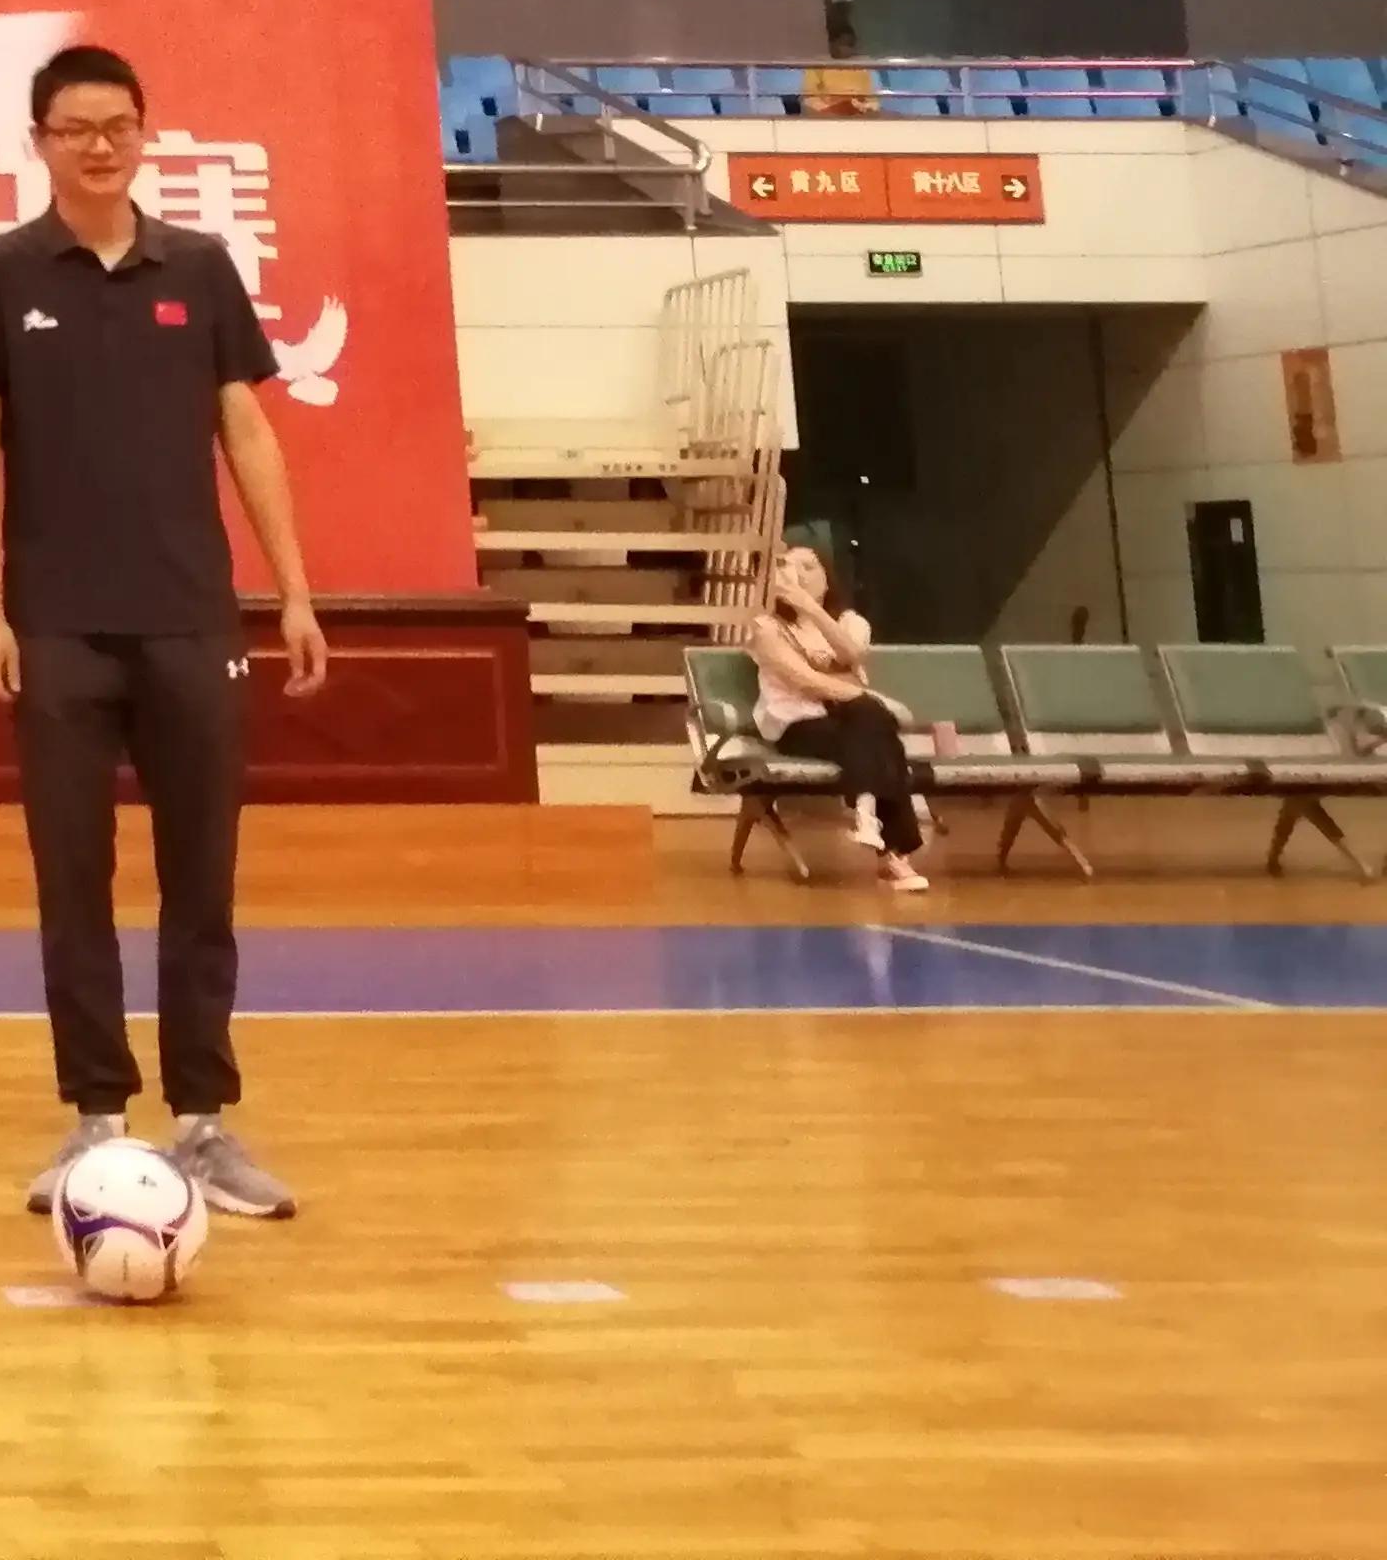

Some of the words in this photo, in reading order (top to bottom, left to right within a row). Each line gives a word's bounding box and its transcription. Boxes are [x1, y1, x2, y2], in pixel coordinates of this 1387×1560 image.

[789, 169, 861, 194] 黄九区
[912, 170, 982, 195] 黄十八区
